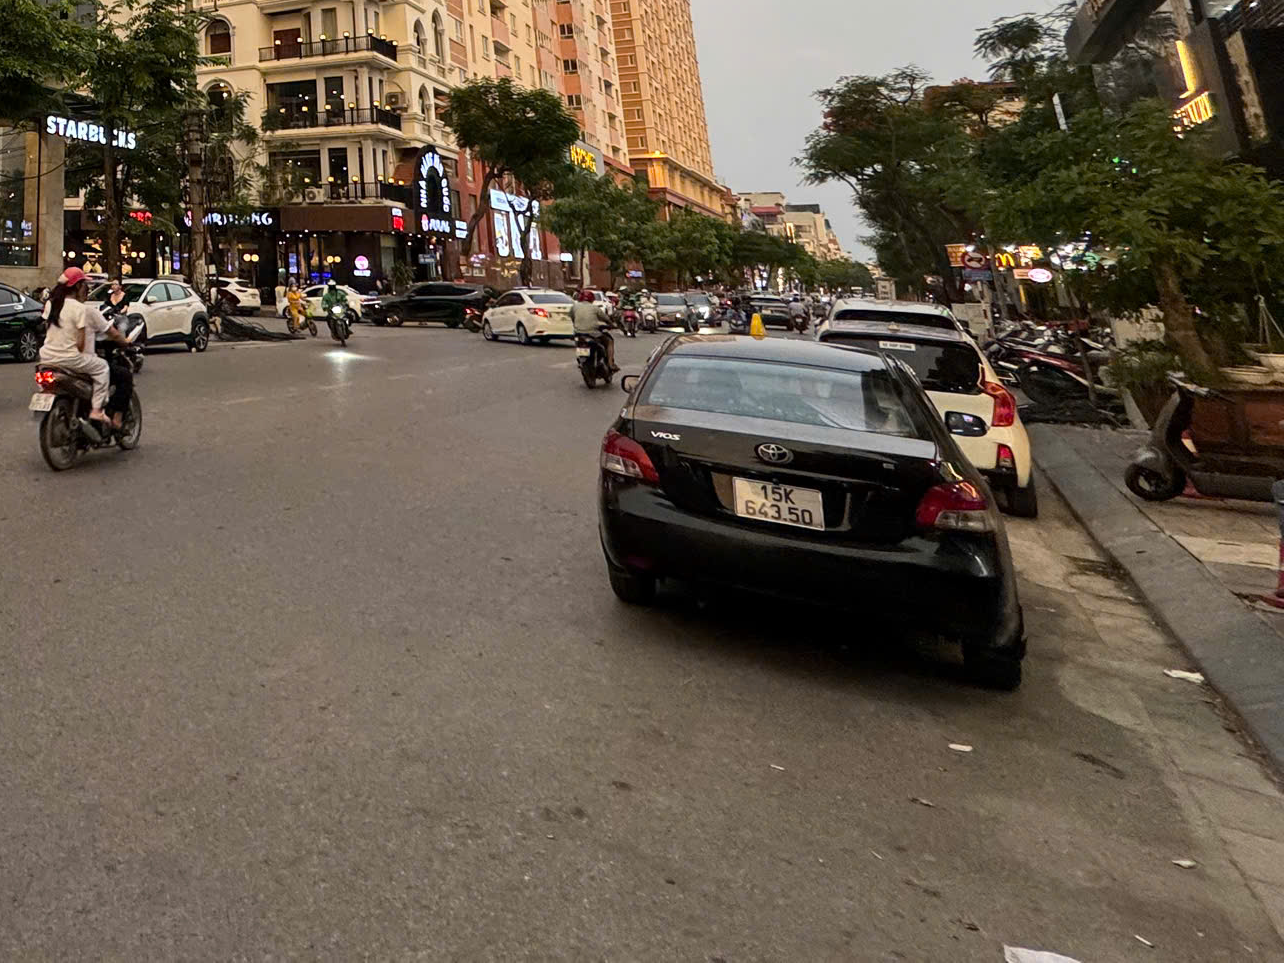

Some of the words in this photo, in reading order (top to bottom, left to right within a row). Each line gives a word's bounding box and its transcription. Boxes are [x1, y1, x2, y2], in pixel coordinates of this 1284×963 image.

[650, 430, 681, 441] VIOS
[760, 484, 796, 505] 15K
[745, 500, 813, 525] 643.50
